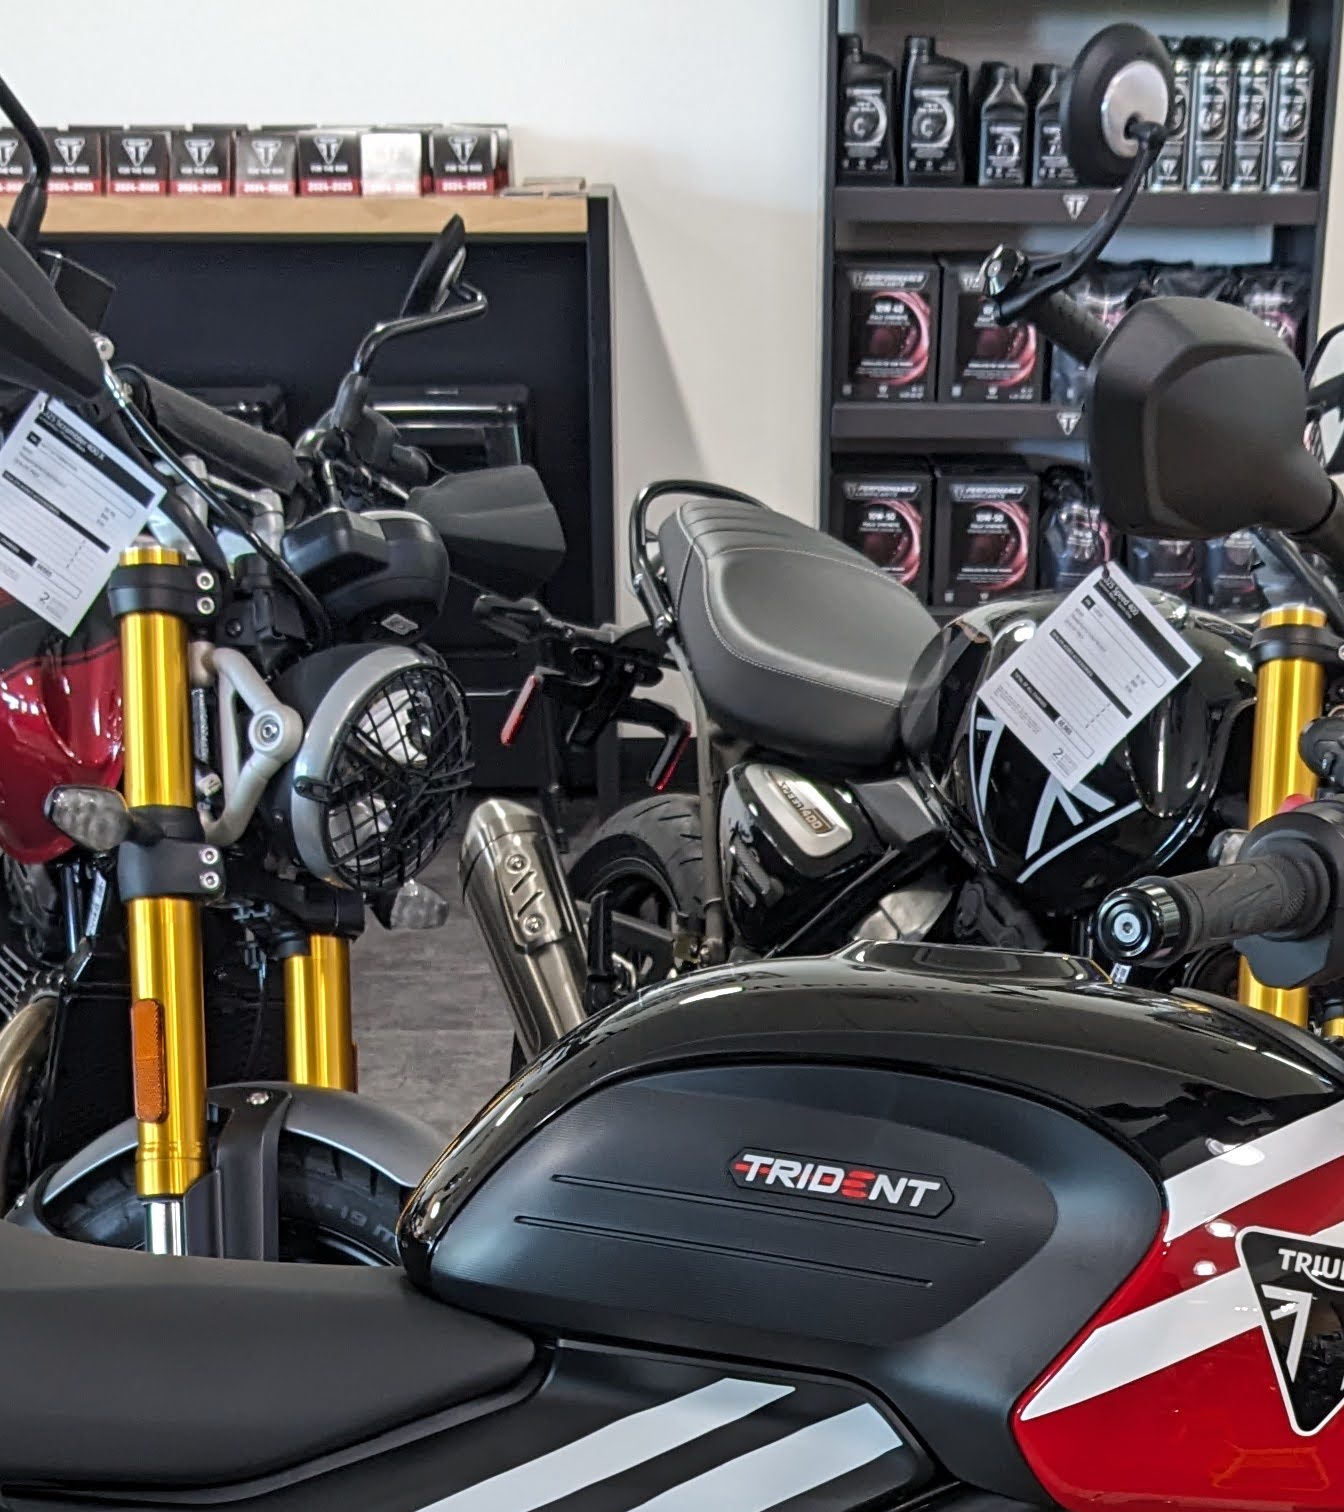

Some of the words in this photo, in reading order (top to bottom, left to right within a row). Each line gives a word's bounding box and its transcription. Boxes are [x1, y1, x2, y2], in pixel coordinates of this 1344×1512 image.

[1110, 586, 1130, 606] Speed
[1125, 602, 1140, 616] 400
[736, 1153, 941, 1207] TRIDENT
